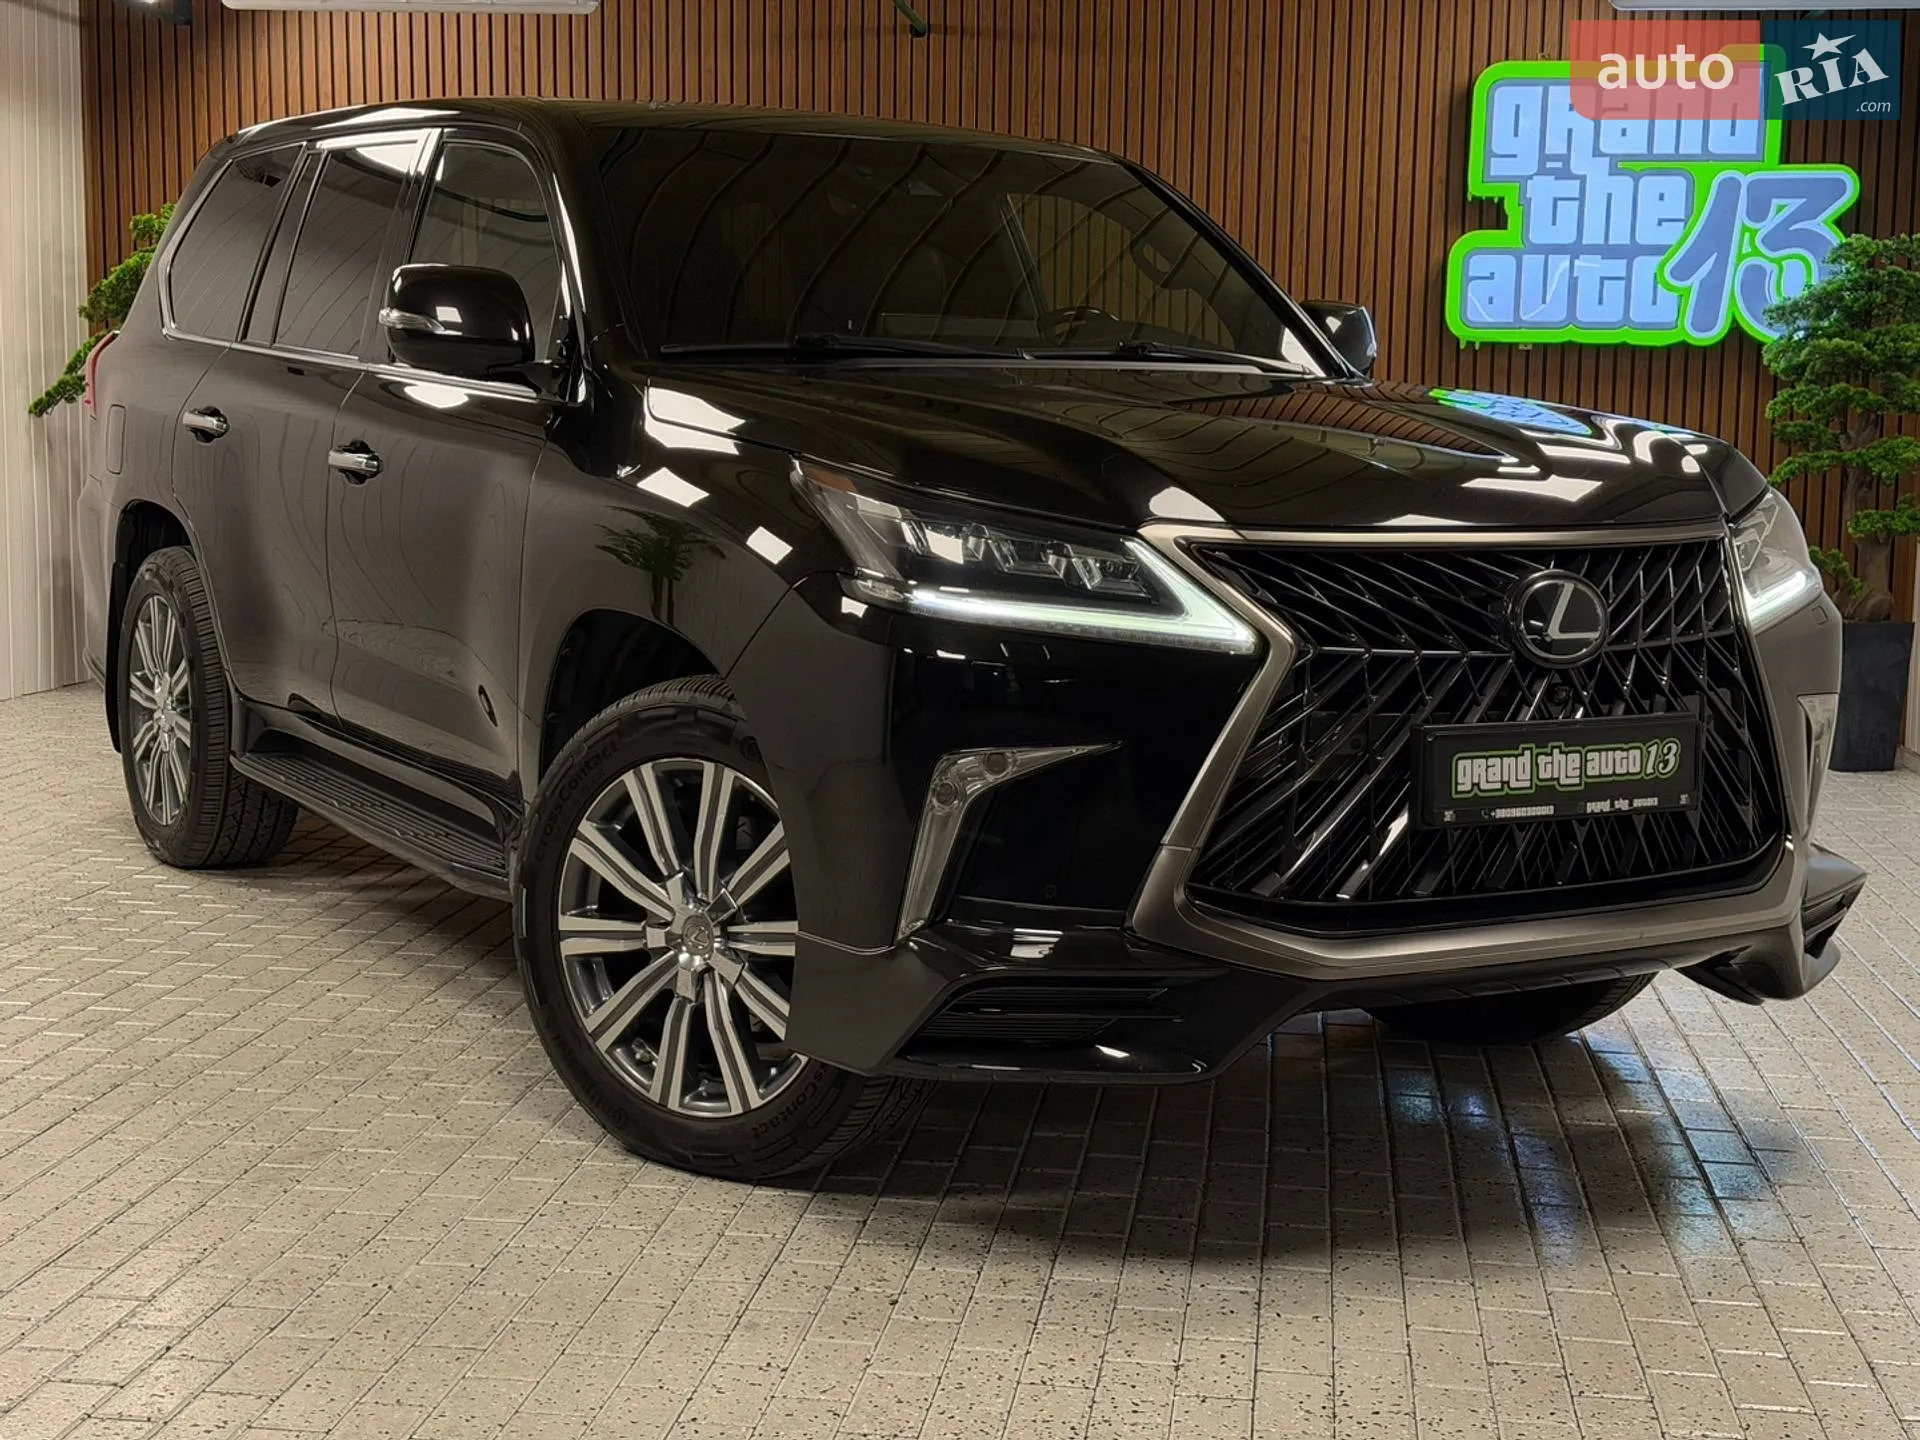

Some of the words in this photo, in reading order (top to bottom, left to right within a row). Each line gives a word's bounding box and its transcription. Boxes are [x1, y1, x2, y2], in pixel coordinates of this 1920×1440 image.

[1527, 158, 1687, 245] the
[1467, 254, 1680, 323] auto
[1666, 171, 1853, 338] 13
[1457, 750, 1531, 791] grand
[1537, 748, 1580, 785] the
